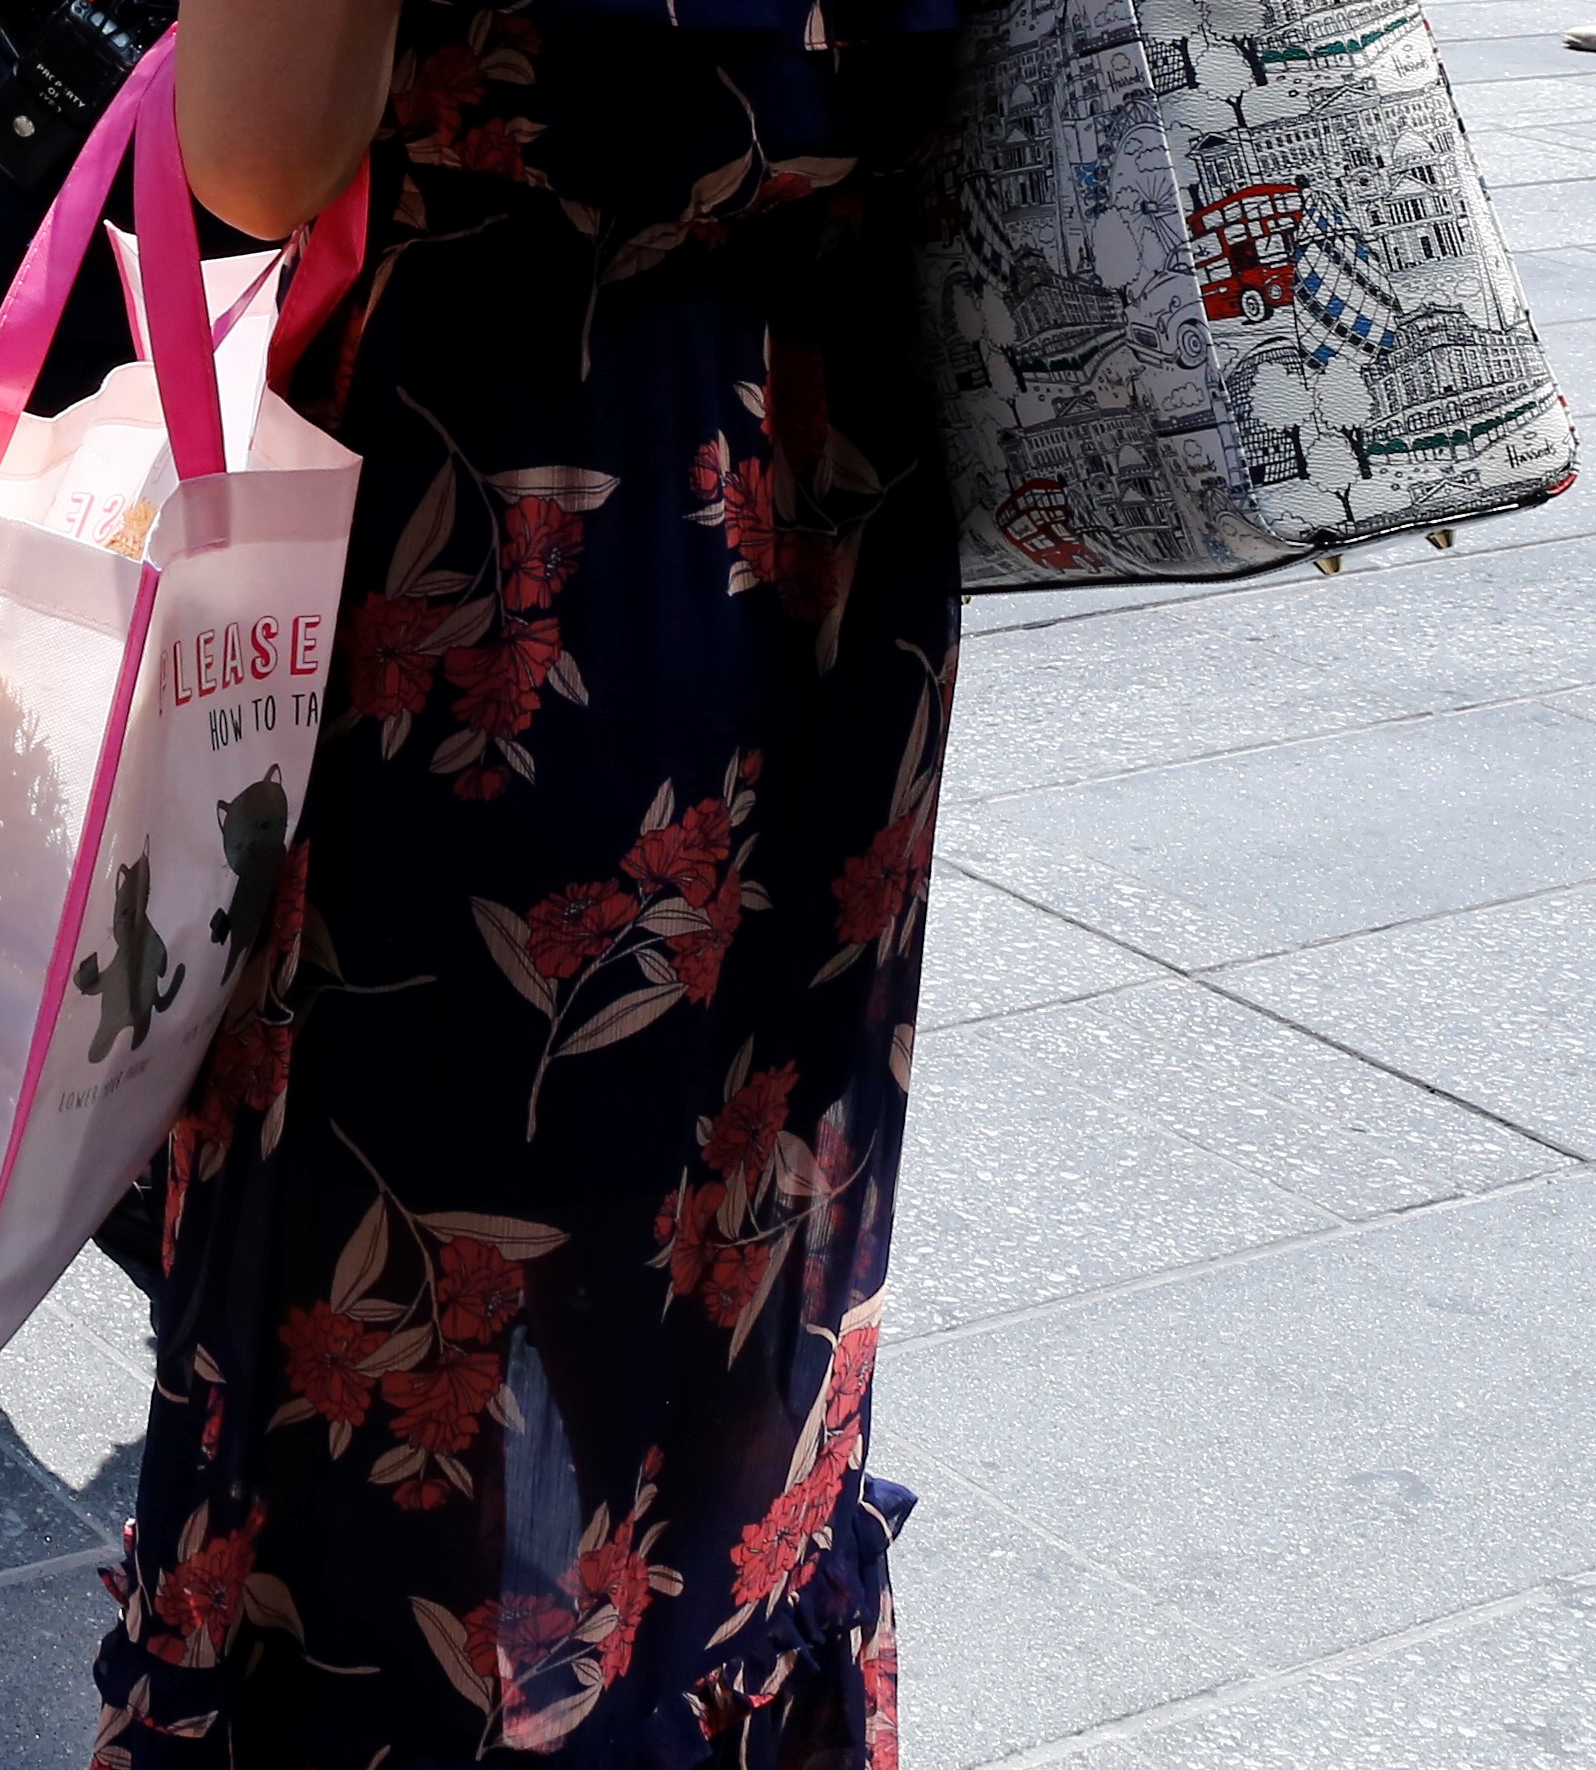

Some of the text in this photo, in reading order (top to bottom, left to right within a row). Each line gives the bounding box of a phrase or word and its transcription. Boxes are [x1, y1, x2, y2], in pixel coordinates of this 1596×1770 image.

[159, 614, 322, 718] PLEASE
[209, 704, 243, 752] HOW
[251, 694, 277, 732] TO
[58, 1085, 99, 1113] LOWER
